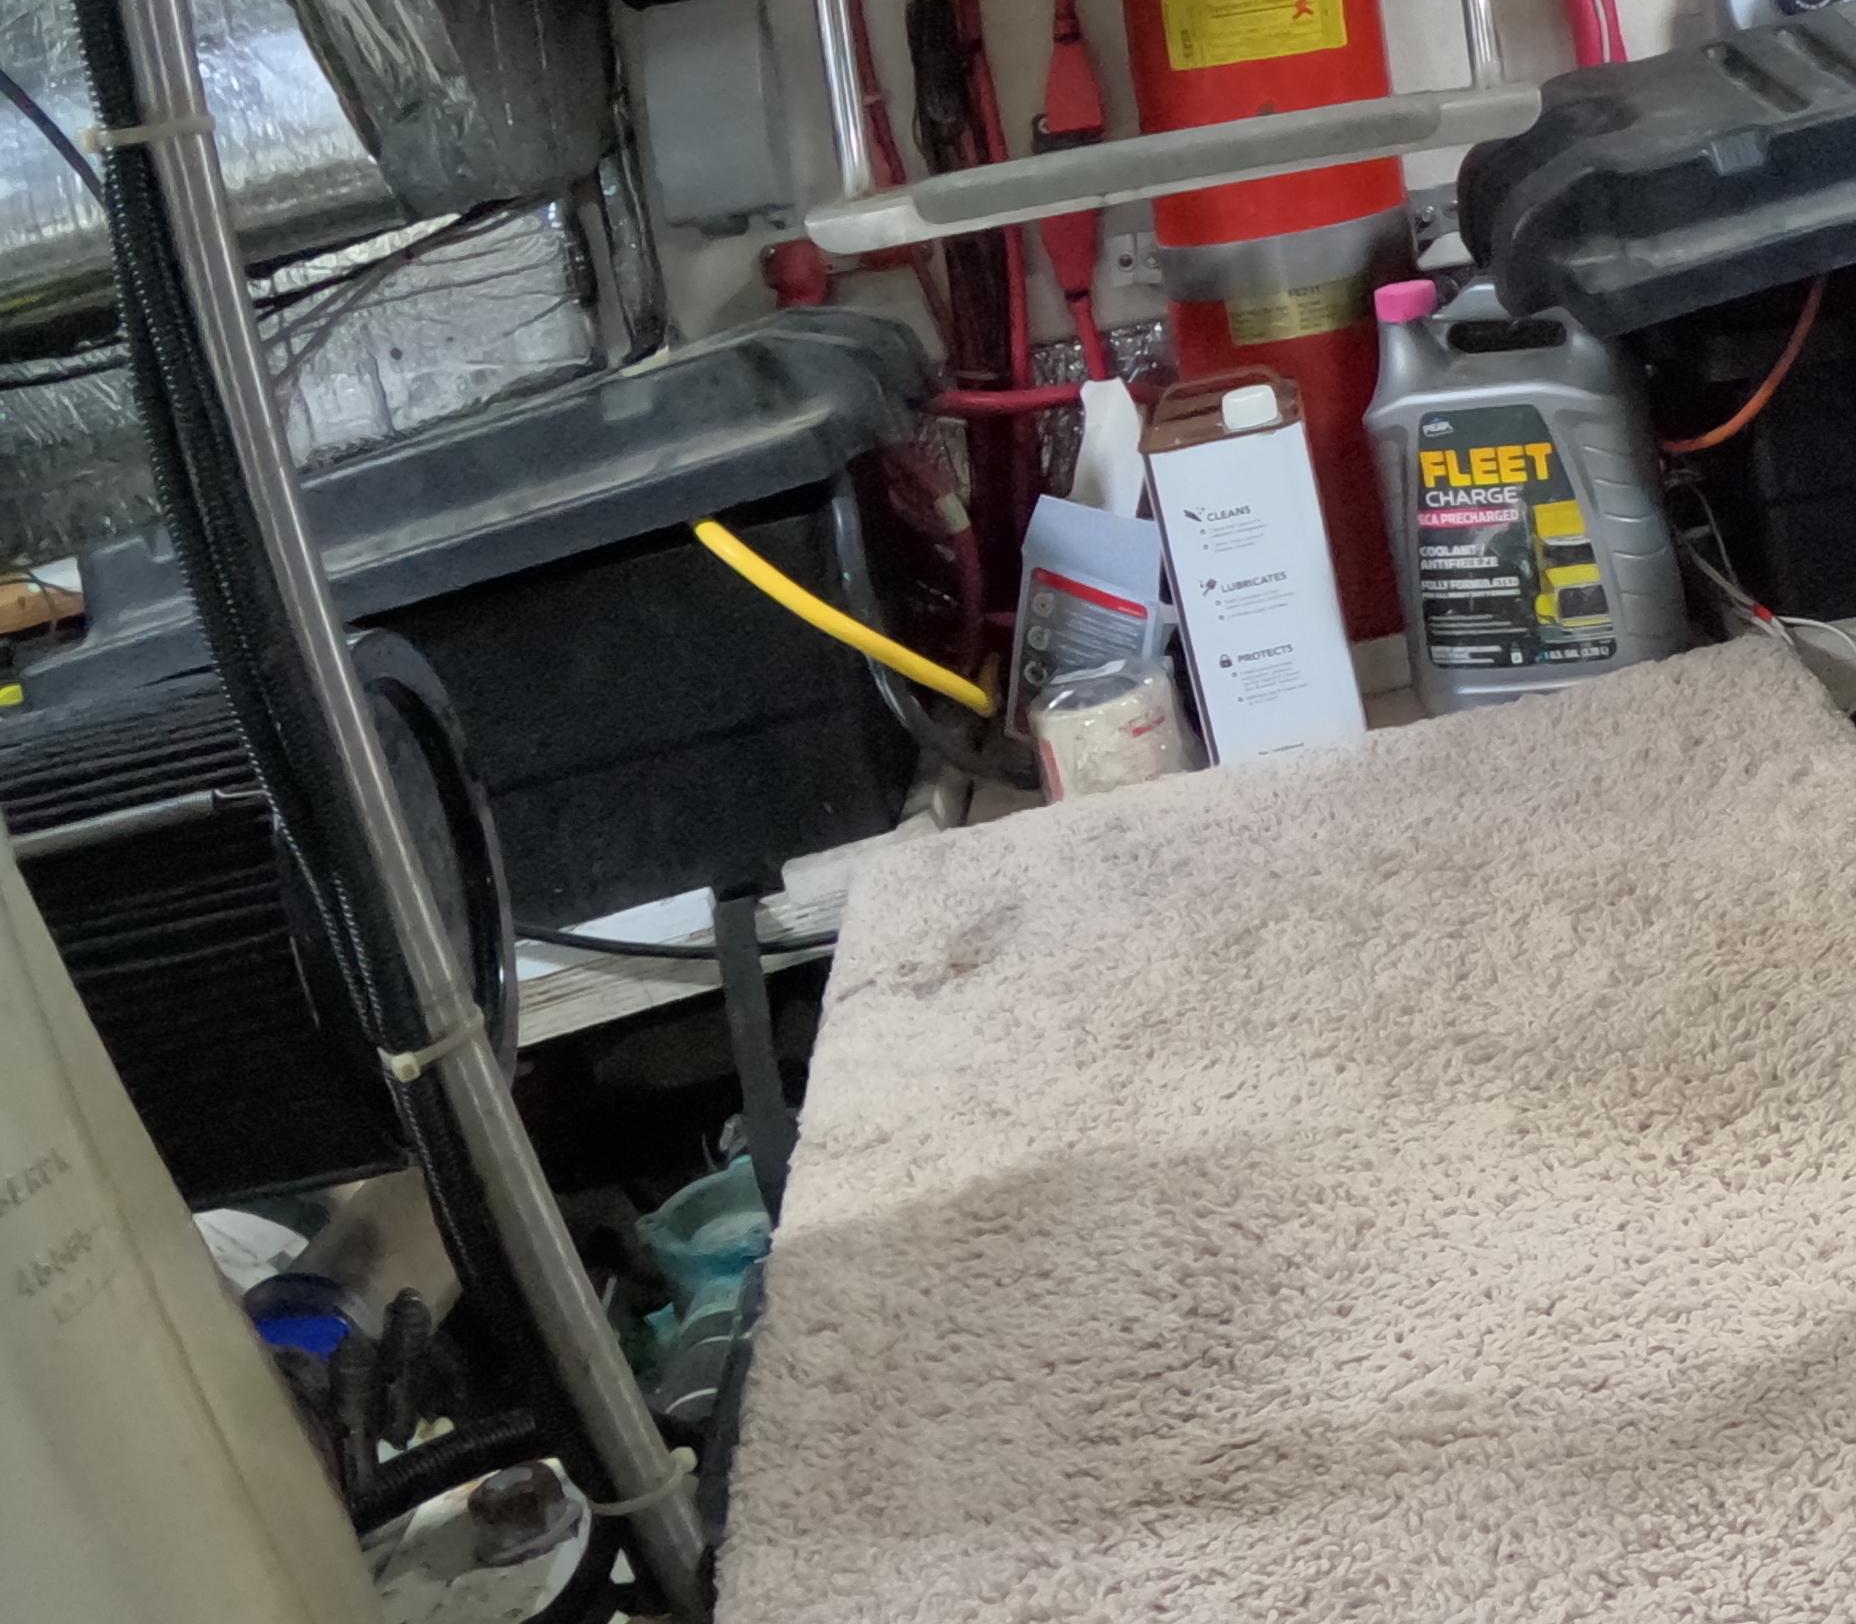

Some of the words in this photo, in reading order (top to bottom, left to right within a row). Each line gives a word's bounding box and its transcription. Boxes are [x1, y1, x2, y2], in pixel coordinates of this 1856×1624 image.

[1419, 442, 1552, 488] FLEET
[1425, 486, 1520, 508] CHARGE
[1206, 505, 1251, 522] CLEANS
[1441, 509, 1520, 525] PRECHARGED
[1420, 556, 1499, 570] ANTIFREEZE
[1220, 571, 1287, 593] LUBRICATES
[1238, 643, 1294, 662] PROTECTS
